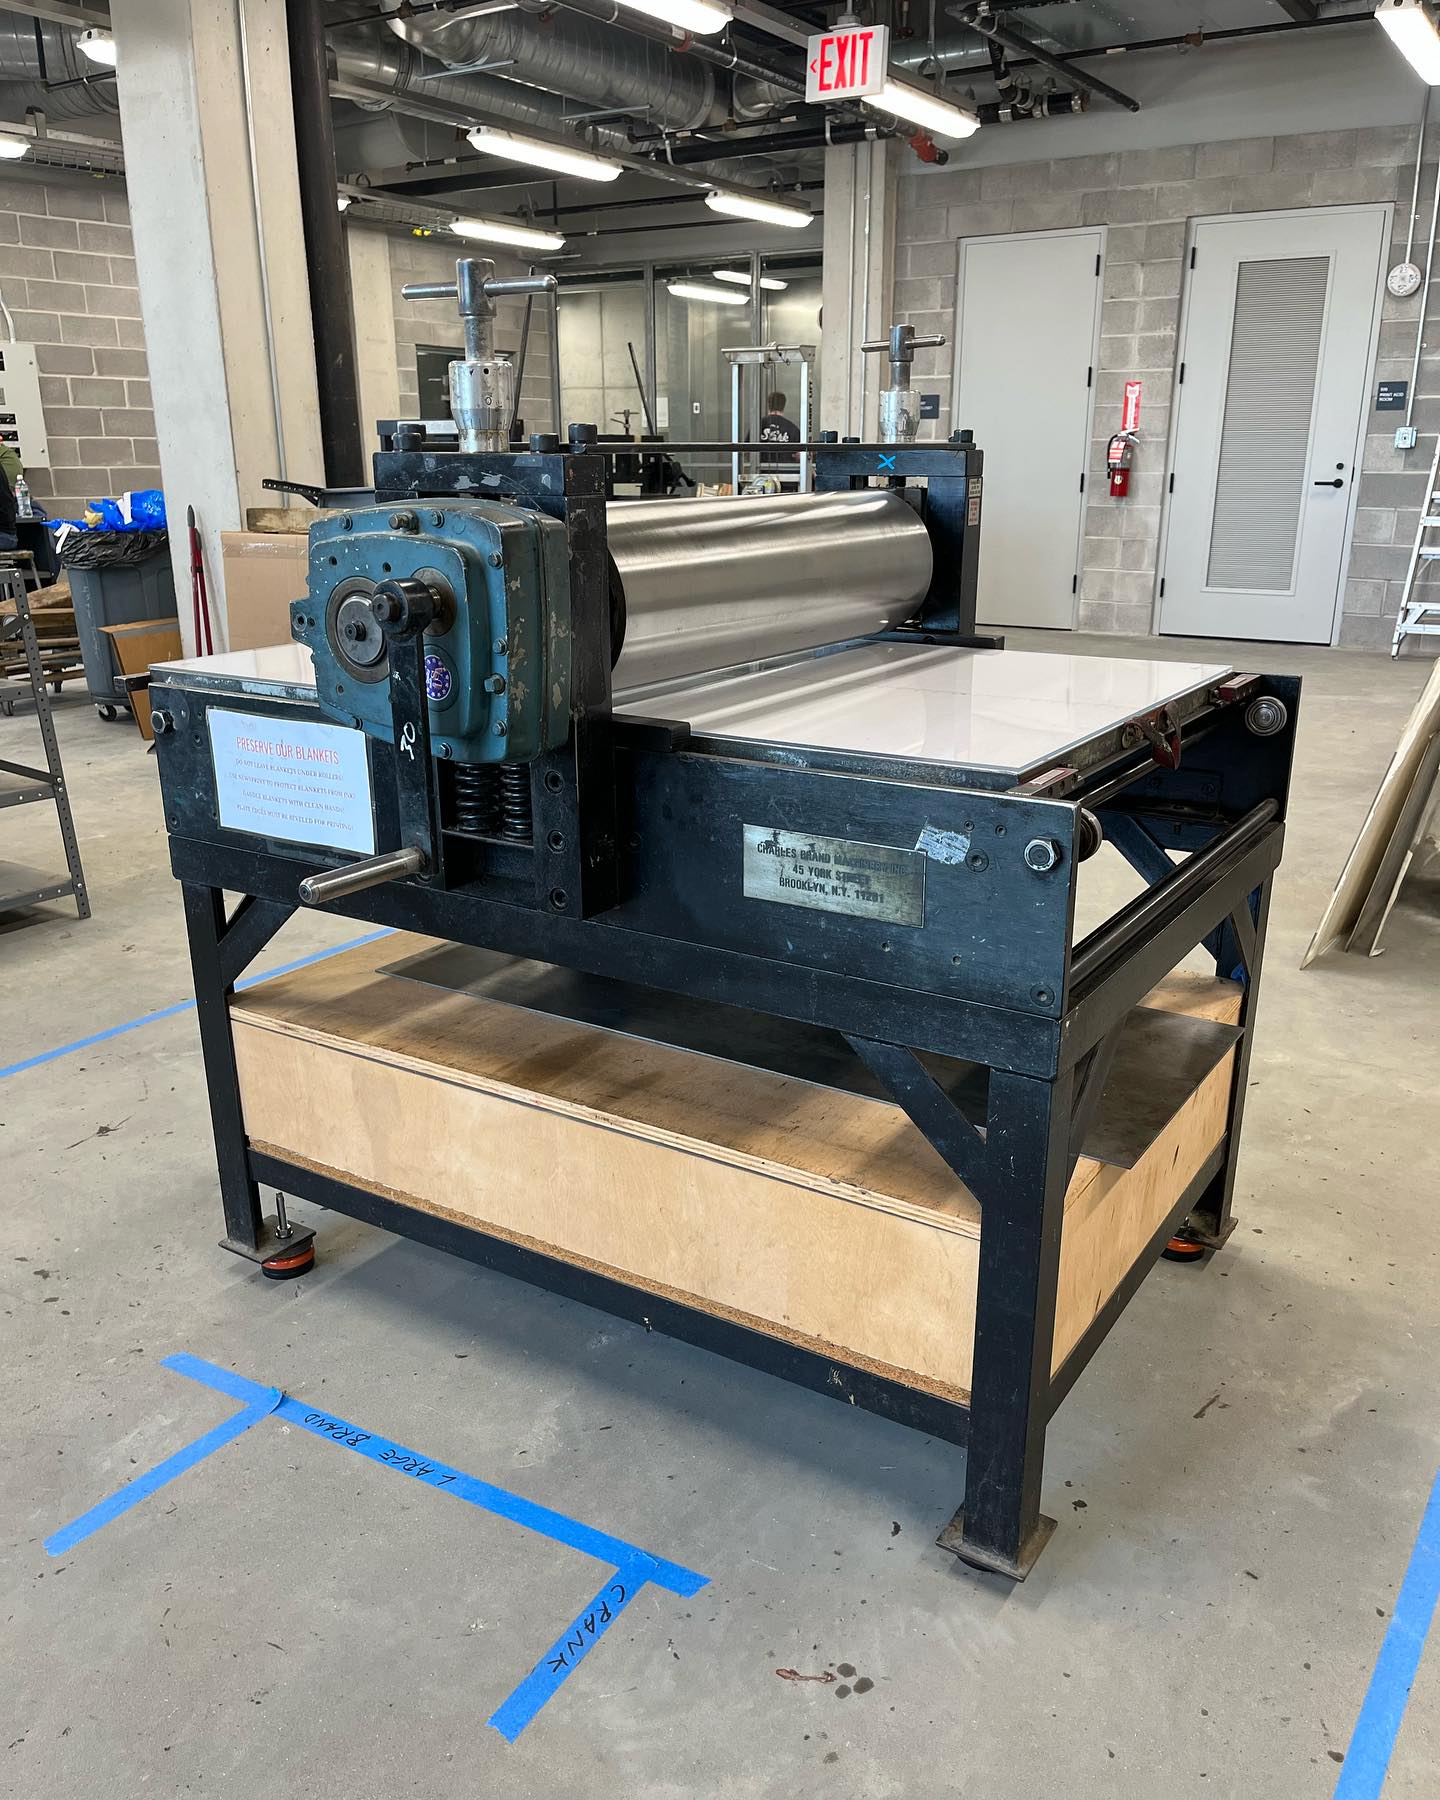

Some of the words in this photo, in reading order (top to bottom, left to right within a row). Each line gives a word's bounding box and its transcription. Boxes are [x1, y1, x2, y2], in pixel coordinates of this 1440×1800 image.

[819, 32, 873, 91] EXIT
[236, 736, 273, 756] PRESERVE
[275, 743, 293, 759] OUR
[296, 746, 339, 765] BLANKETS
[297, 769, 317, 778] UNDER
[757, 843, 797, 858] CHARLES
[800, 849, 831, 864] BRAND
[793, 864, 804, 875] 45
[808, 866, 832, 880] YORK
[779, 877, 828, 896] BROOKLYN,
[854, 889, 884, 904] 11201
[304, 1413, 371, 1447] BRAND
[378, 1449, 457, 1486] LARGE
[547, 1584, 626, 1673] CRANK
